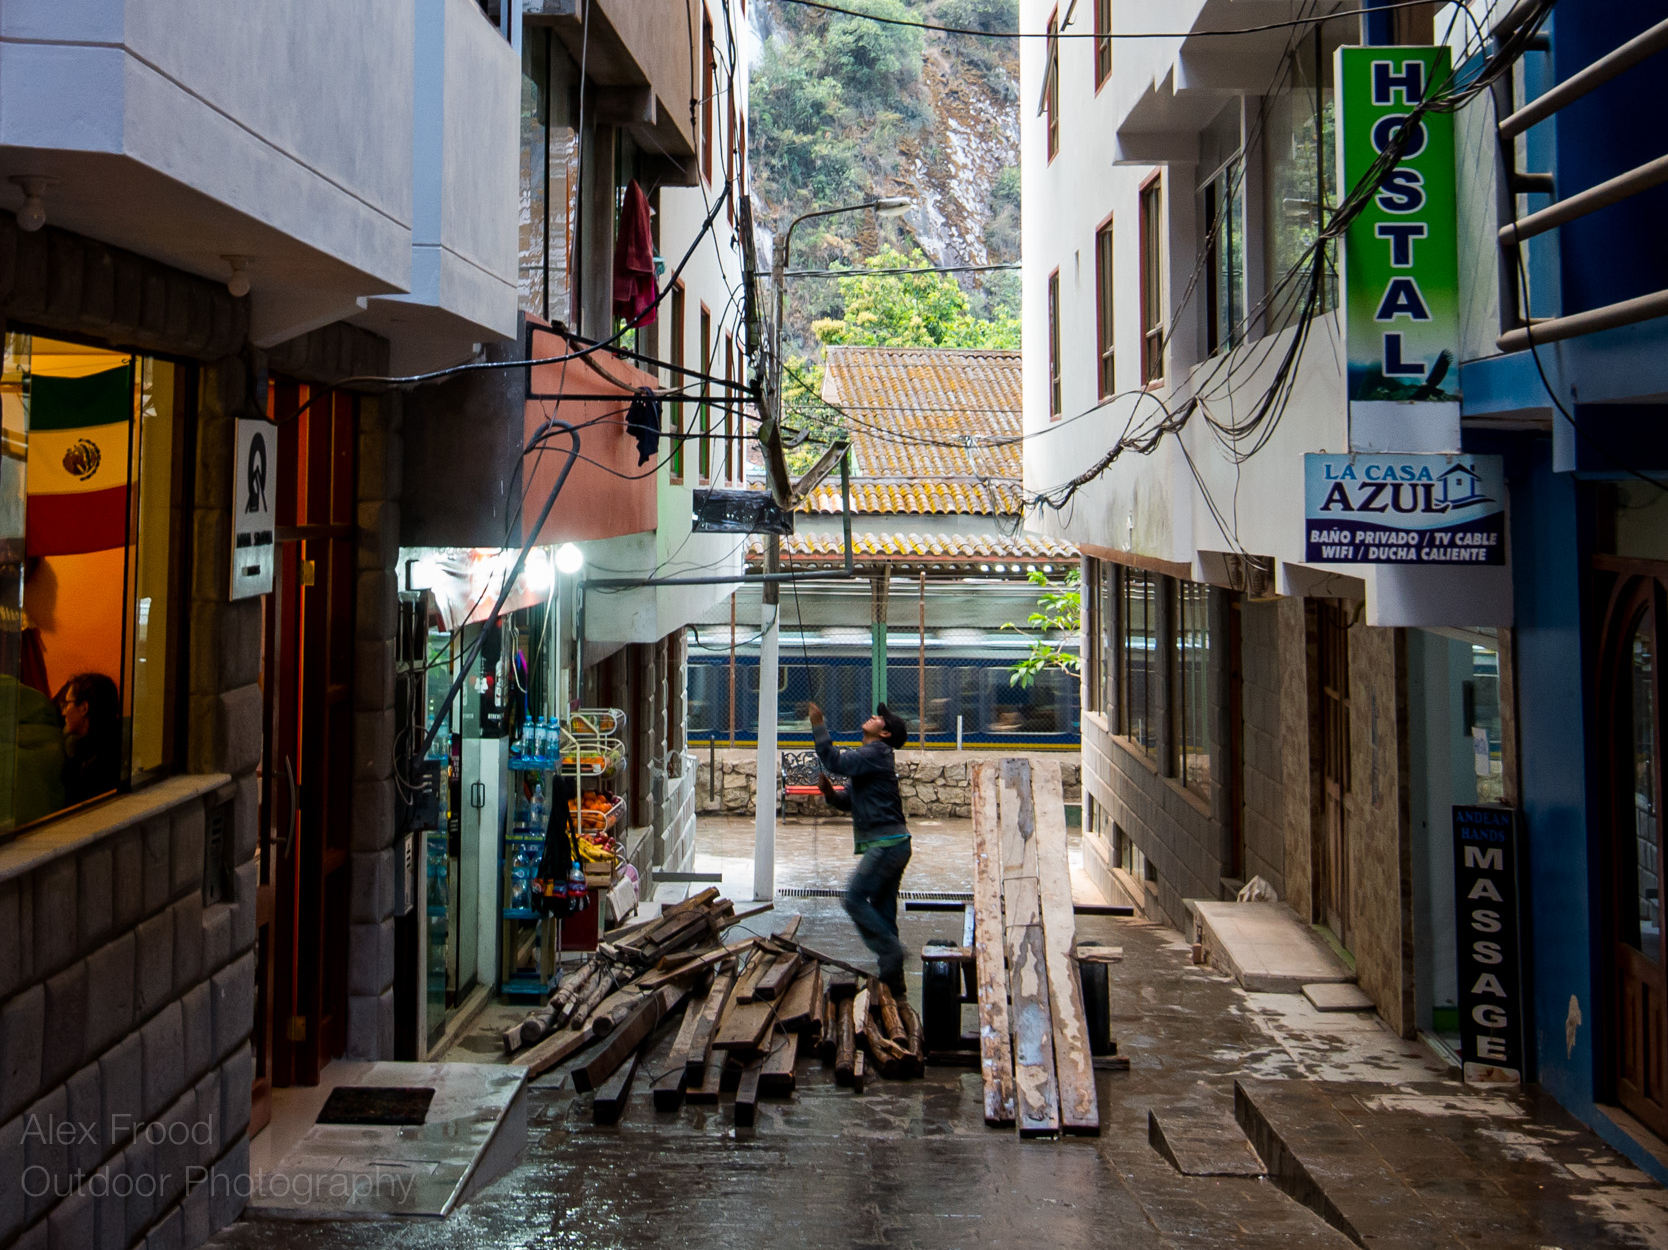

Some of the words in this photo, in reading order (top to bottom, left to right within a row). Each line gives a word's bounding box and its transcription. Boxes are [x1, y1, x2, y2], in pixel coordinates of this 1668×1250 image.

[1371, 60, 1433, 377] HOSTAL
[1324, 464, 1357, 480] LA
[1364, 464, 1433, 481] CASA
[1319, 481, 1452, 513] AZUL
[1310, 527, 1350, 543] BAÑO
[1355, 531, 1419, 545] PRIVADO
[1434, 533, 1452, 545] TV
[1455, 533, 1497, 546] CABLE
[1321, 546, 1353, 559] WIFI
[1368, 546, 1417, 560] DUCHA
[1421, 547, 1486, 561] CALIENTE
[1455, 809, 1510, 826] ANDEAN
[1461, 826, 1506, 842] HANDS
[1464, 845, 1508, 1061] MASSAGE
